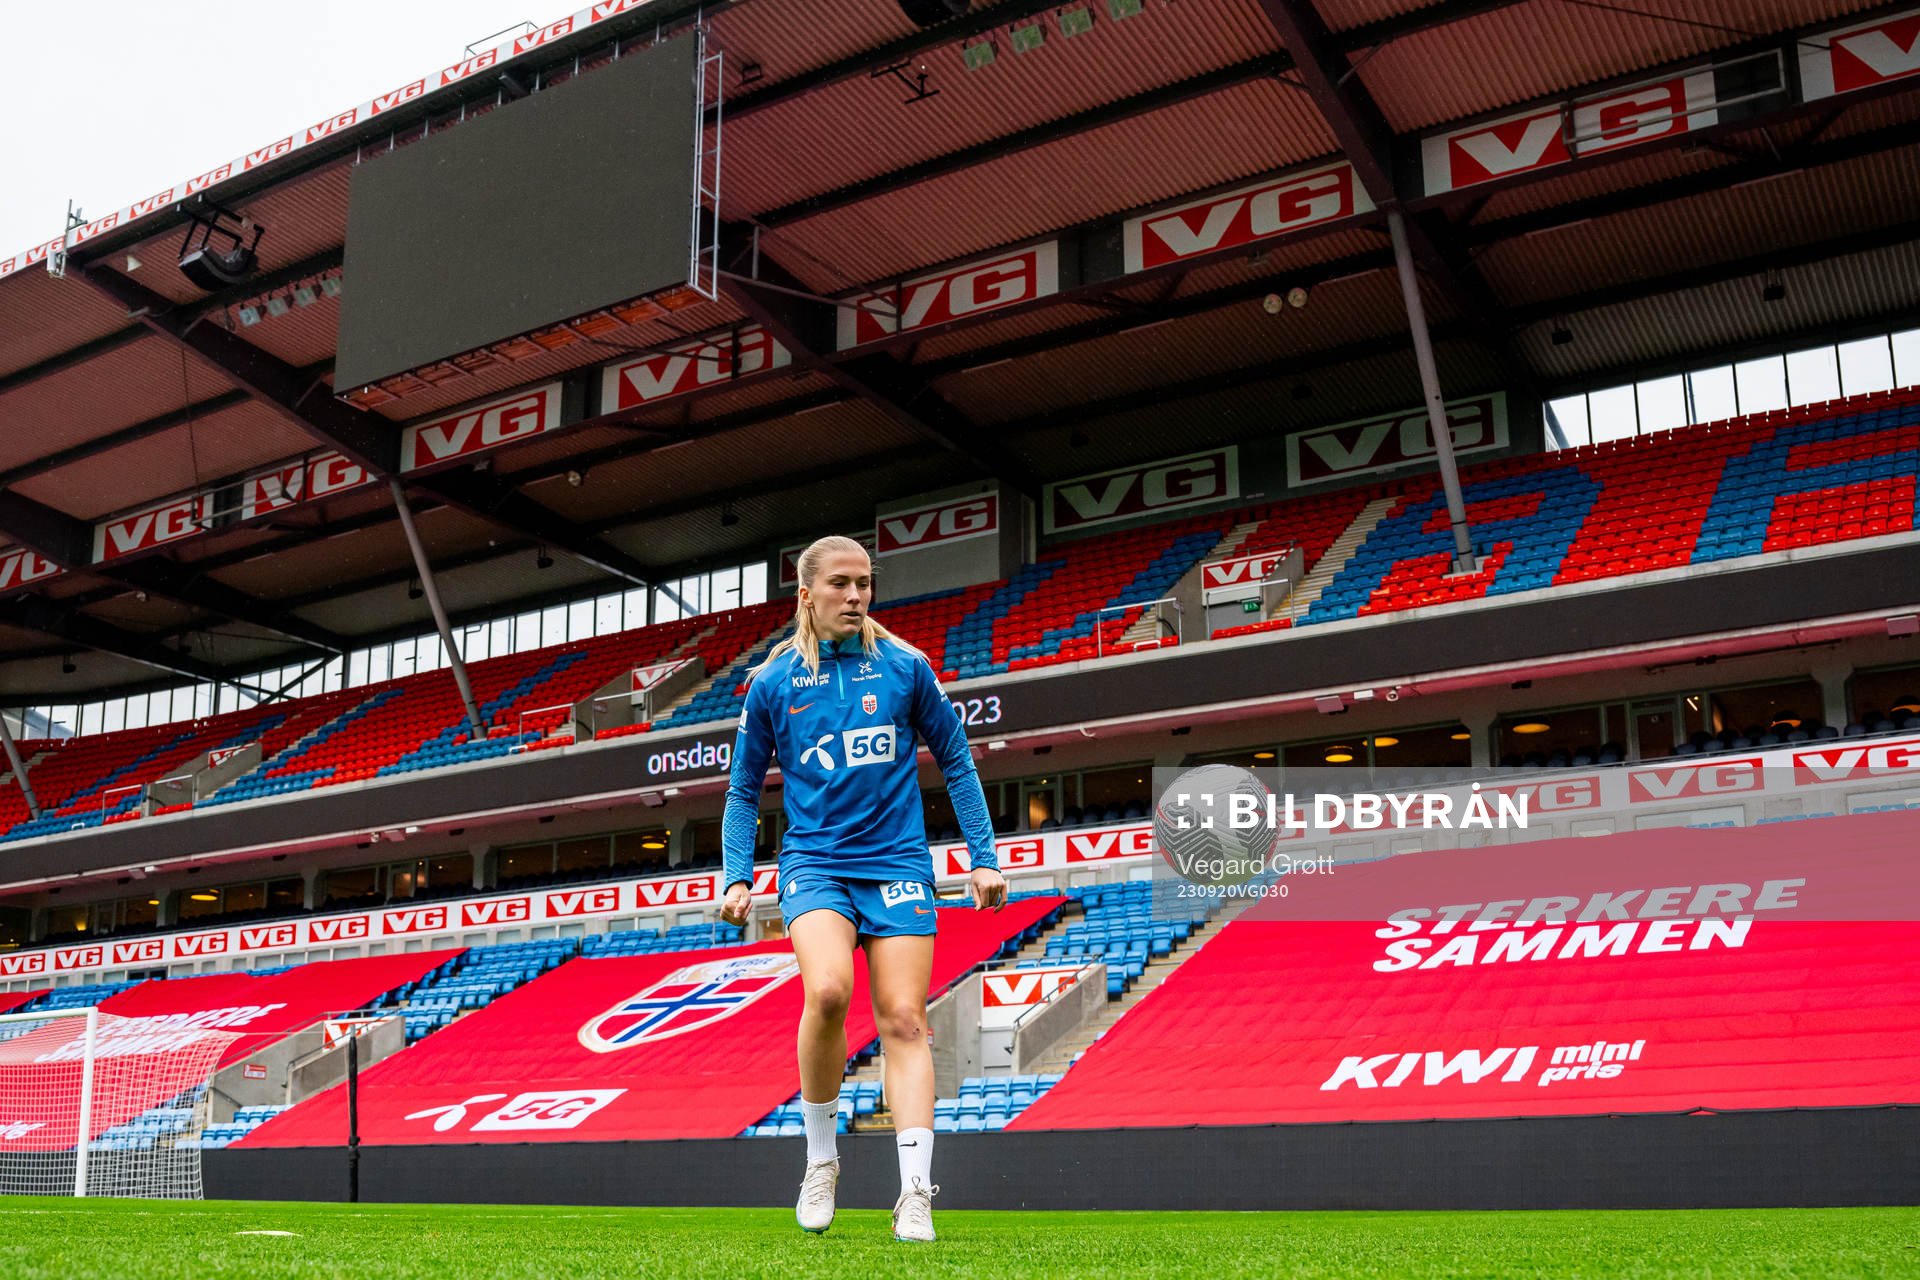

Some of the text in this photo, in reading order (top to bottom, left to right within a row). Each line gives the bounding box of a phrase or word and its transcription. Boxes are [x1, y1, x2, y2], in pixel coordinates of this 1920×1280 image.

[79, 215, 117, 240] VG
[131, 191, 172, 217] VG
[188, 165, 230, 192] VG
[247, 138, 291, 167] VG
[308, 110, 355, 140] VG
[375, 81, 424, 111] VG
[443, 50, 496, 82] VG
[515, 18, 572, 51] VG
[1455, 87, 1672, 175] VG
[1147, 173, 1341, 257] VG
[860, 260, 1026, 332] VG
[624, 332, 765, 400] VG
[420, 398, 538, 459] VG
[1303, 405, 1484, 472] VG
[260, 455, 363, 506] VG
[1058, 458, 1217, 520] VG
[108, 504, 199, 552] VG
[883, 501, 988, 545] VG
[648, 696, 1001, 775] onsdag 023
[851, 732, 891, 759] 5G
[2, 955, 44, 974] VG
[58, 948, 101, 969] VG
[115, 942, 162, 962] VG
[177, 934, 226, 955] VG
[242, 925, 295, 948] VG
[311, 918, 368, 941] VG
[385, 909, 445, 933] VG
[464, 900, 529, 925] VG
[549, 889, 618, 916] VG
[638, 878, 713, 906] VG
[1070, 829, 1157, 859] VG
[1633, 763, 1754, 799] VG
[1799, 745, 1920, 781] VG
[887, 881, 919, 900] 5G
[1374, 878, 1806, 940] STERKERE
[1372, 914, 1754, 973] SAMMEN
[1320, 1039, 1647, 1091] KIWI mini
[1537, 1060, 1626, 1087] pris
[497, 1095, 598, 1121] 5G
